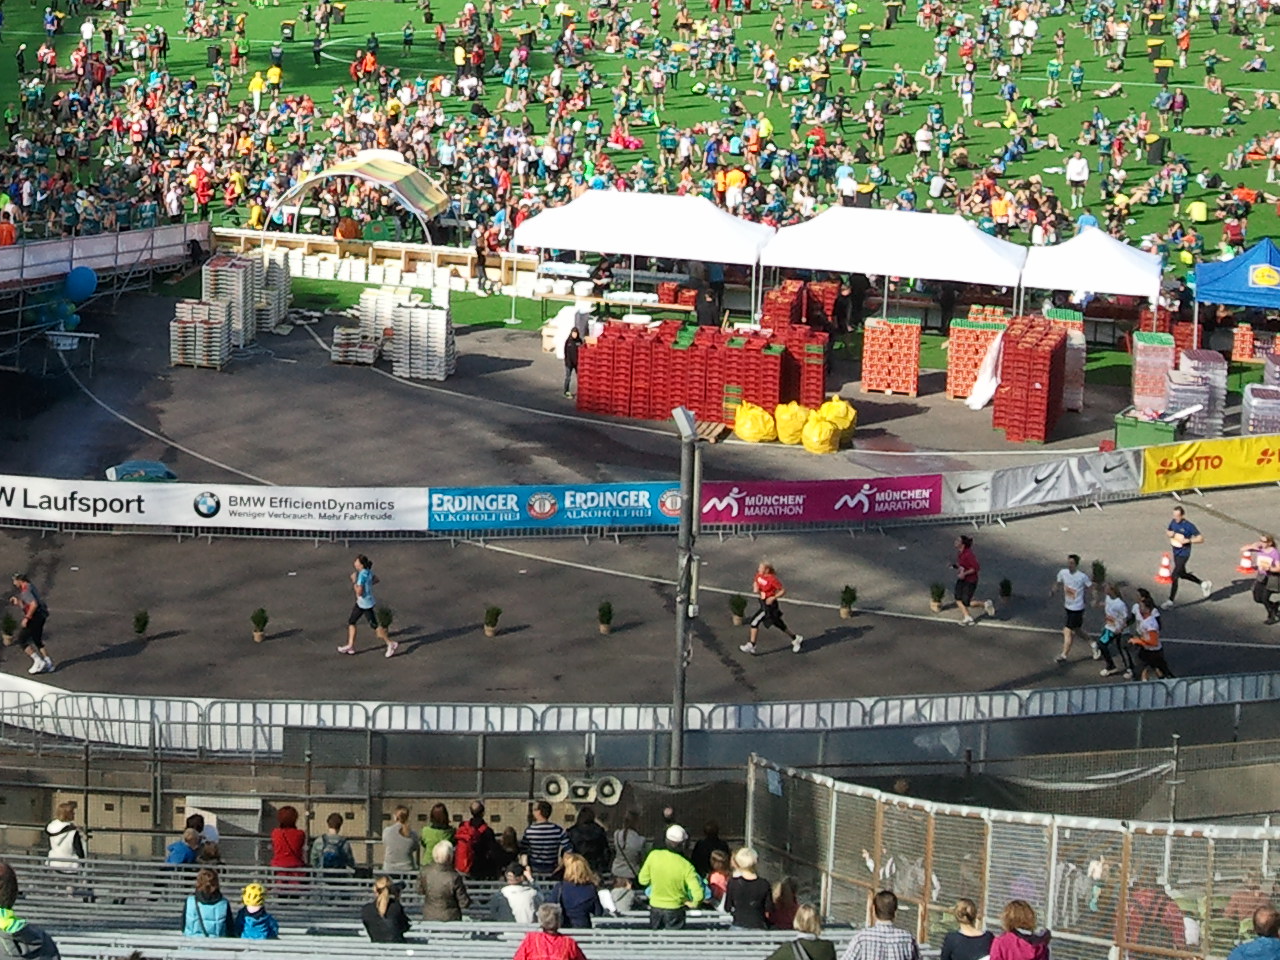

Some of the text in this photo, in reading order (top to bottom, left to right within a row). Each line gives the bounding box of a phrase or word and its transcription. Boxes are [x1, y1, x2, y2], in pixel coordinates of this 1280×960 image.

[1174, 455, 1223, 473] LOTTO
[23, 488, 145, 517] Laufsport
[431, 493, 519, 513] ERDINGER
[564, 490, 652, 509] ERDINGER
[744, 495, 803, 506] MÜNCHEN
[875, 489, 931, 502] MÜNCHEN
[228, 496, 395, 514] BMW EfficientDynamics
[744, 505, 803, 516] MARATHON
[874, 499, 930, 512] MARATHON
[228, 510, 265, 519] Weniger
[268, 511, 316, 520] Verbrauch.
[343, 512, 395, 521] Fahrfreude.
